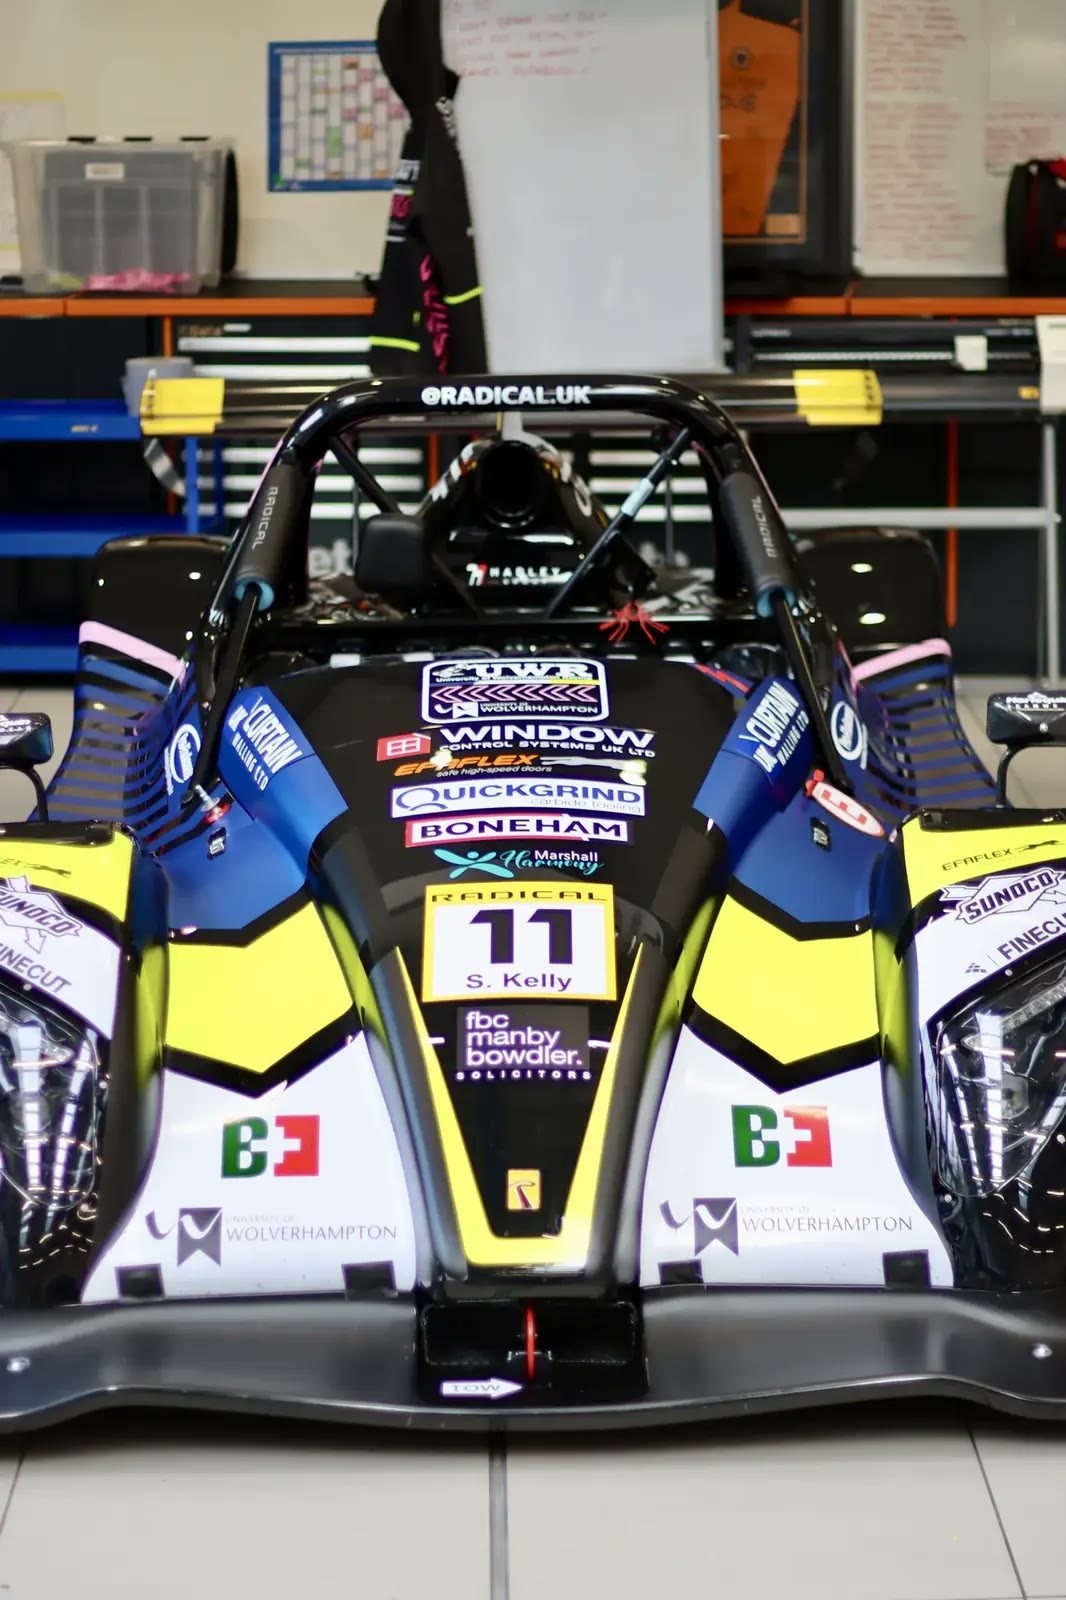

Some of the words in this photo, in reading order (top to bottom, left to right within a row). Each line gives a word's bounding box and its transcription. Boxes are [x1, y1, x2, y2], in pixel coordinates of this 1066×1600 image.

[421, 385, 591, 406] @RADICAL.UK
[251, 486, 279, 550] RADICAL
[751, 495, 778, 558] RADICAL
[480, 704, 598, 713] WOLVERHAMPTON
[745, 681, 800, 748] CURTAIN
[243, 700, 302, 774] CURTAIN
[440, 724, 656, 748] WINDOW
[776, 725, 801, 767] WALLING
[795, 710, 810, 732] LTD
[440, 740, 513, 752] CONTROL
[518, 740, 596, 751] SYSTEMS
[602, 744, 623, 754] UK
[628, 747, 656, 758] LTD
[232, 731, 258, 773] WALLING
[253, 765, 270, 791] LTD
[436, 768, 459, 778] safe
[460, 765, 520, 776] high-speed
[522, 765, 553, 773] doors
[395, 783, 641, 812] QUICKGRIND
[530, 797, 588, 807] carbide
[592, 799, 642, 814] tooling
[420, 819, 622, 839] BONEHAM
[499, 850, 605, 876] Harmony
[534, 850, 598, 862] Marshall
[942, 847, 1013, 872] EFAFLEX
[431, 890, 608, 902] RADICAL
[965, 871, 1054, 921] SUNOCO
[469, 908, 573, 965] 11
[0, 943, 71, 993] INECUT
[466, 974, 492, 989] S.
[503, 972, 573, 992] Kelly
[465, 1010, 509, 1029] fbc
[467, 1025, 561, 1048] manby
[466, 1045, 583, 1066] bowdler.
[456, 1070, 592, 1080] SOLICITORS
[226, 1225, 397, 1241] WOLVERHAMPTON
[742, 1216, 913, 1232] WOLVERHAMPTON
[453, 1383, 500, 1392] TOW
